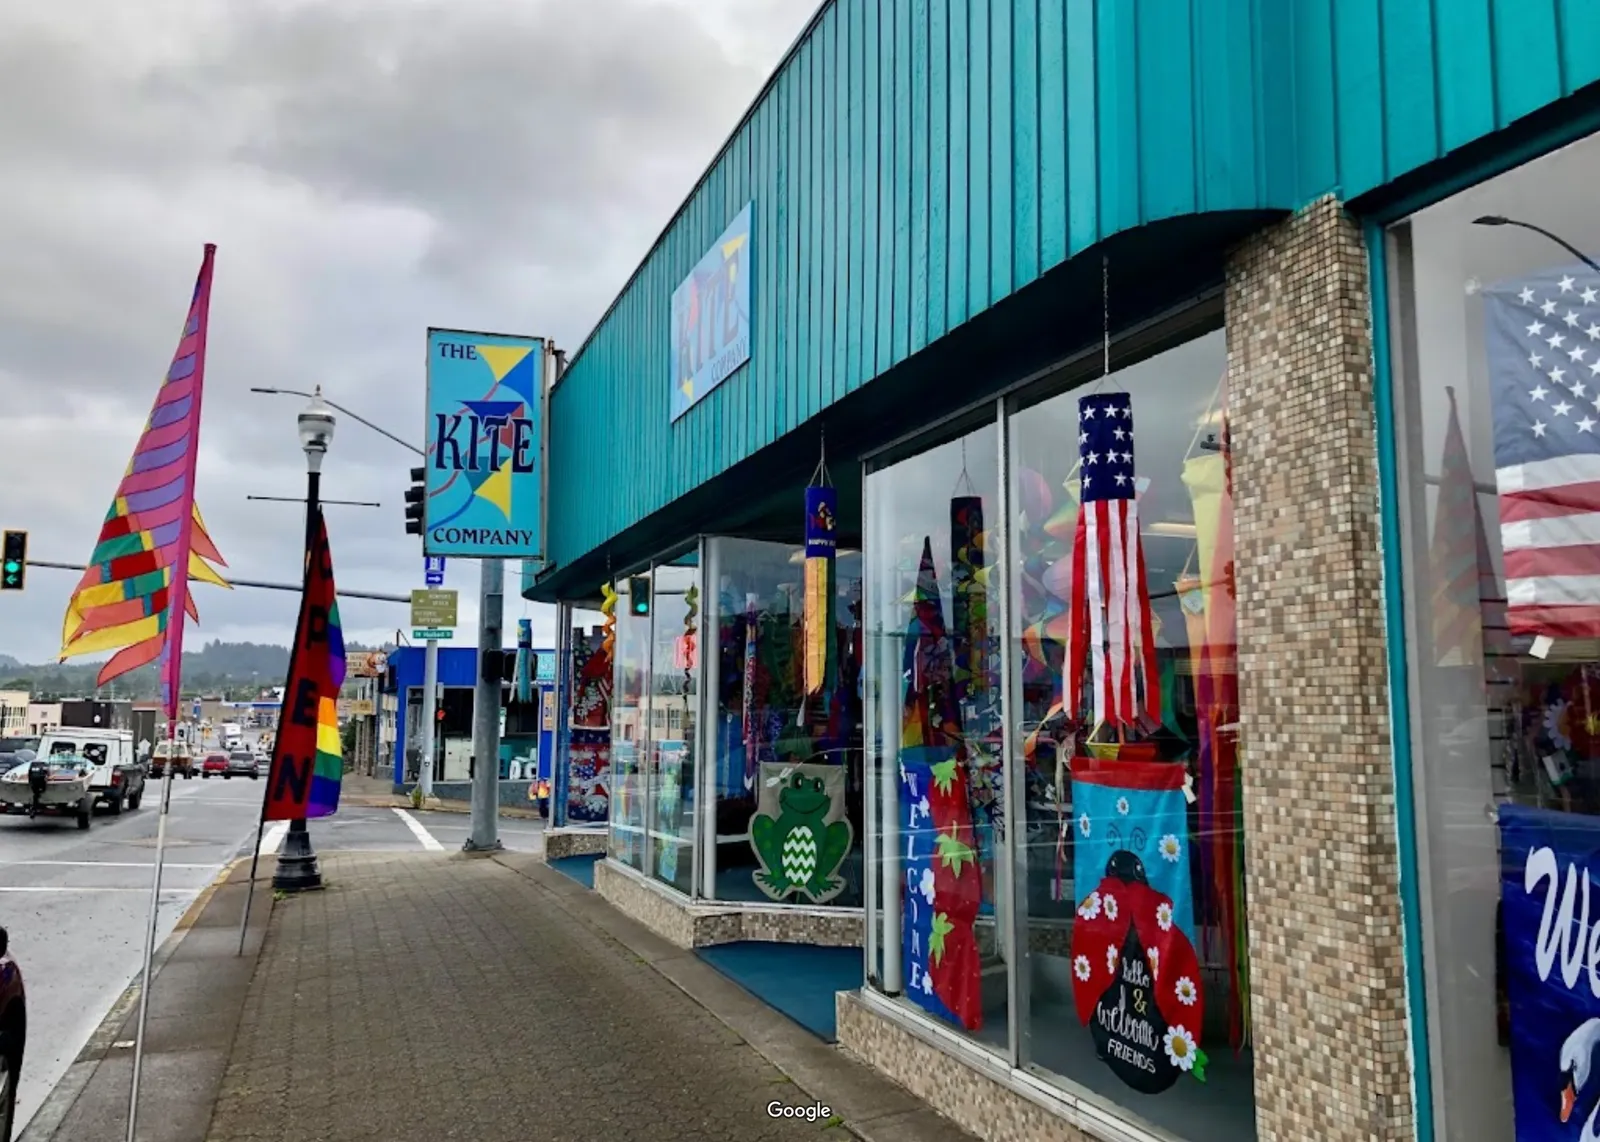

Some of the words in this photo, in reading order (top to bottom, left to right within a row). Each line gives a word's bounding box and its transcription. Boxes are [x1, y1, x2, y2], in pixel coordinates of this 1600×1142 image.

[677, 247, 740, 391] KITE
[437, 342, 477, 360] THE
[711, 335, 748, 383] COMPANY
[435, 413, 536, 474] KITE
[433, 528, 533, 546] COMPANY
[1122, 957, 1150, 988] hello
[1097, 984, 1159, 1051] welcome
[1107, 1038, 1156, 1074] FRIENDS
